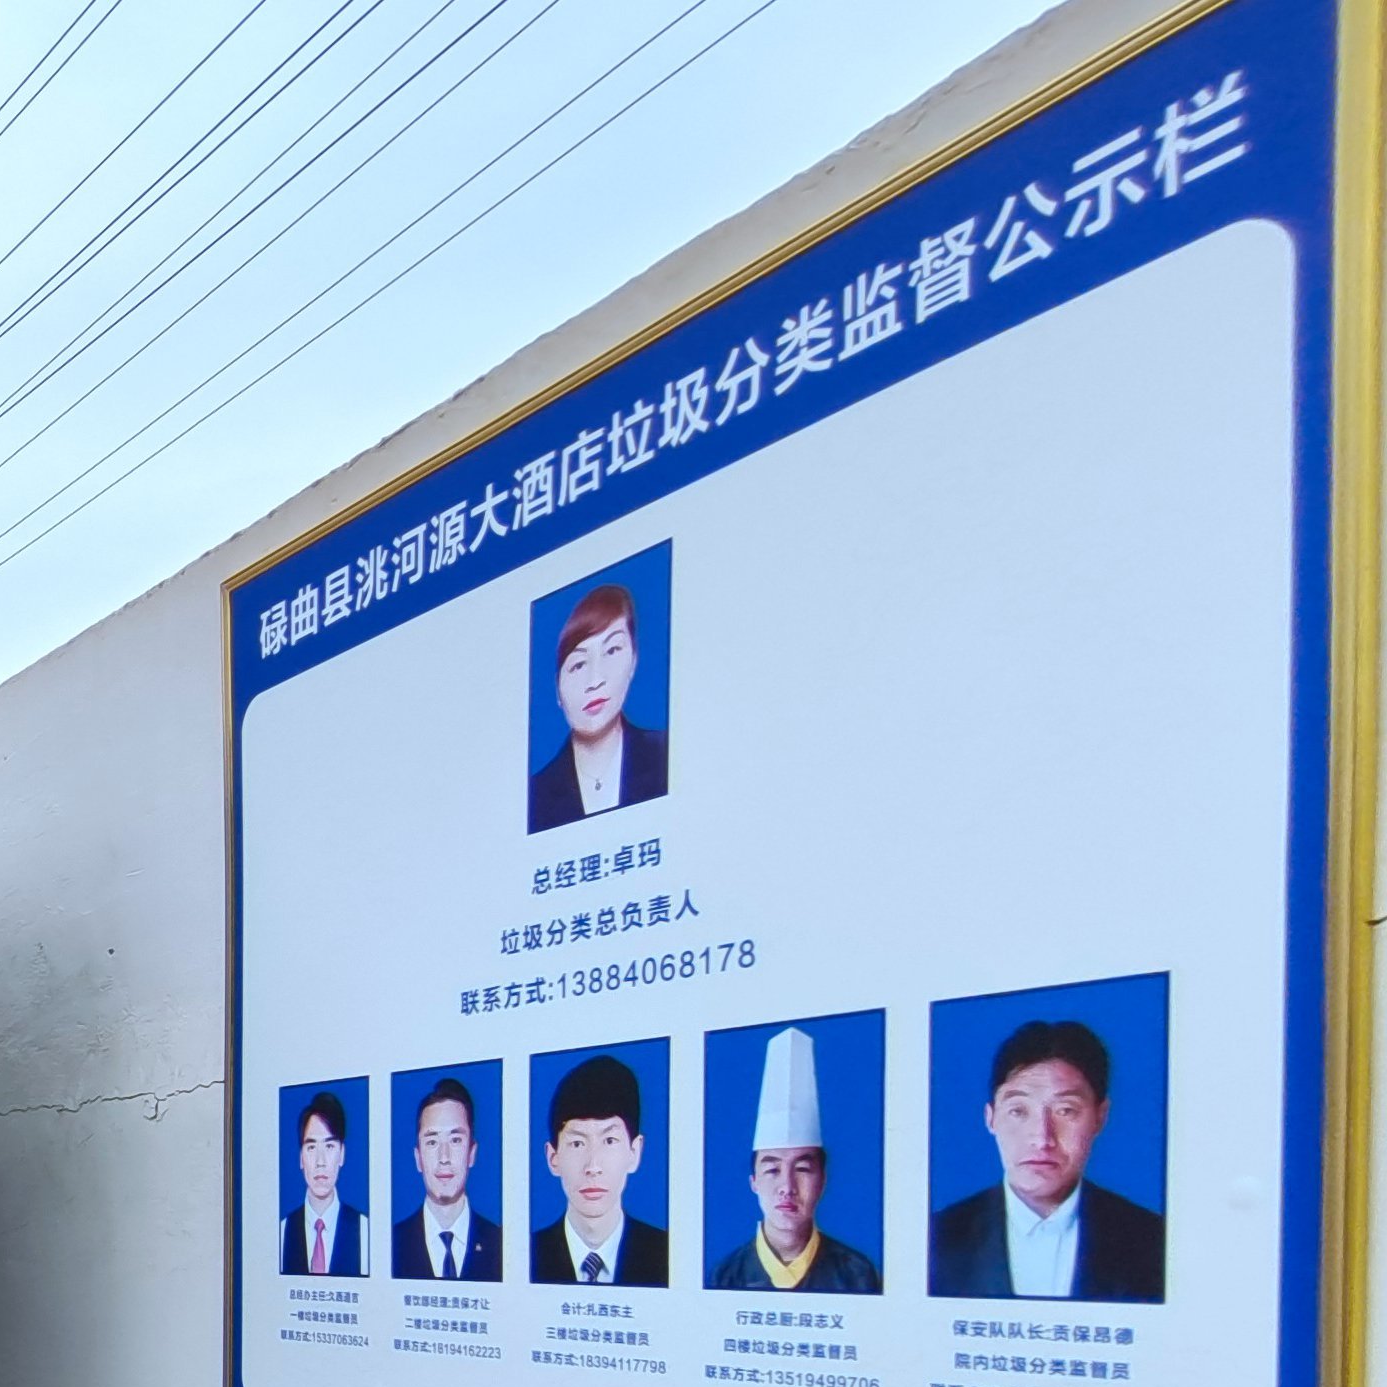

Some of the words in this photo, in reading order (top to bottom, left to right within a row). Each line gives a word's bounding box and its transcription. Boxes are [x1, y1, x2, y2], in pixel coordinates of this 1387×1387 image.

[258, 71, 1249, 660] 碌曲县洮河源大酒店垃圾分类监督公示栏
[531, 838, 662, 895] 总经理:卓玛
[500, 889, 700, 955] 垃圾分类总负责人
[460, 939, 756, 1016] 联系方式:13884068178
[546, 1326, 650, 1346] 三楼垃圾分类监督员
[724, 1337, 858, 1362] 四楼垃圾分类监督员
[531, 1350, 667, 1375] 联系方式:18394117798
[954, 1352, 1131, 1380] 院内垃圾分类监督员
